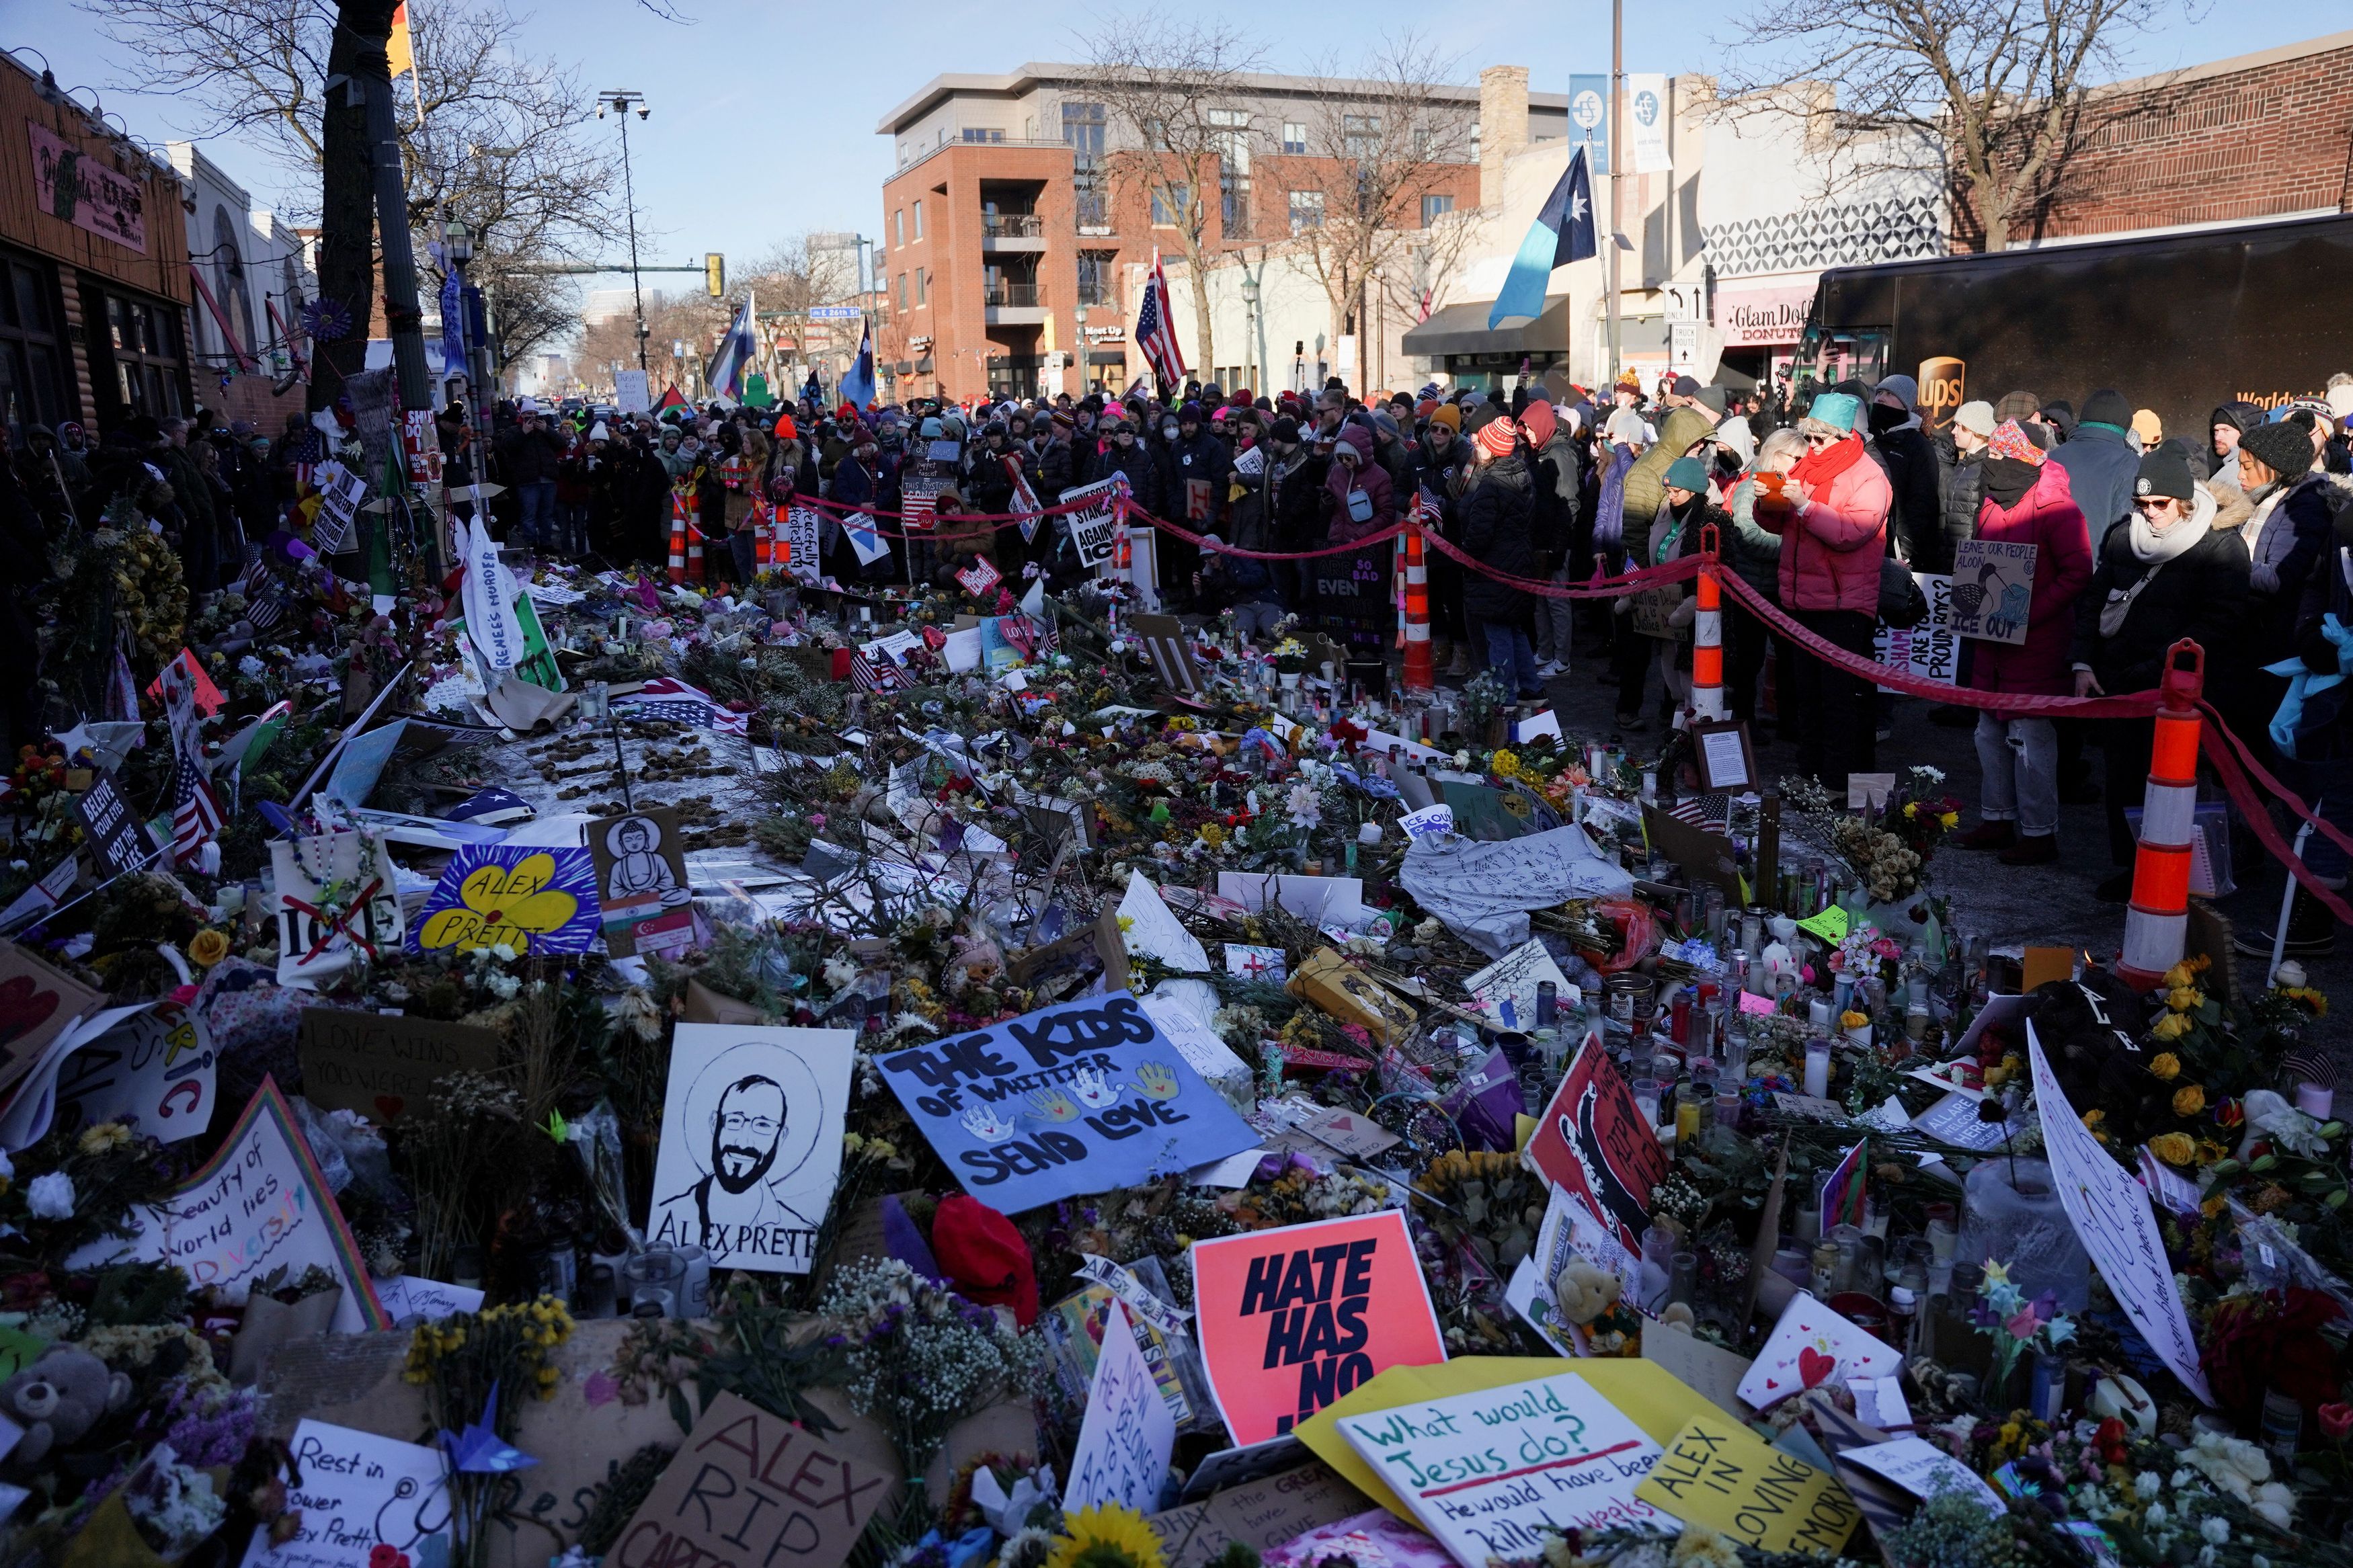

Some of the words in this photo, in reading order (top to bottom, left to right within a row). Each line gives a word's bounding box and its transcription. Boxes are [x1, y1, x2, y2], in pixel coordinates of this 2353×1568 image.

[829, 308, 847, 317] 26th
[849, 308, 860, 317] St
[1666, 311, 1683, 319] ONLY
[1734, 304, 1777, 328] Glam
[1085, 327, 1107, 335] Meet
[1109, 326, 1123, 336] Up
[1675, 328, 1696, 337] TRUCK
[1675, 337, 1696, 347] ROUTE
[1921, 376, 1962, 417] ups
[917, 462, 936, 470] puppet
[803, 509, 818, 568] Peacefully
[1078, 520, 1113, 548] AGAINS
[1081, 541, 1113, 565] IC
[1357, 559, 1373, 571] SO
[1958, 542, 1985, 554] LEAVE
[1988, 542, 2004, 556] OUR
[2005, 545, 2037, 560] PEOPLE
[481, 551, 500, 606] MURDER
[1317, 579, 1360, 597] EVEN
[1352, 569, 1380, 582] BAD
[1951, 612, 1981, 634] ICE
[1986, 616, 2018, 639] OUT
[1911, 637, 1930, 667] ARE
[1928, 630, 1954, 679] PROUD
[93, 812, 114, 839] YOUR
[109, 798, 124, 823] EYES
[1404, 815, 1423, 828] ICE
[107, 835, 127, 866] NOT
[121, 822, 138, 848] THE
[467, 872, 546, 899] ALEX
[310, 1019, 385, 1054] LOVE
[882, 1032, 1017, 1087] THE
[1007, 998, 1156, 1069] KIDS
[916, 1087, 963, 1118] OF
[1927, 1114, 1953, 1130] ALL
[1950, 1098, 1974, 1116] ARE
[1940, 1106, 1981, 1136] WELCOM
[1954, 1119, 1993, 1144] HERE
[959, 1130, 1088, 1186] SEND
[1084, 1098, 1190, 1142] LOVE
[241, 1174, 279, 1219] lies
[654, 1210, 729, 1251] ALEX
[1240, 1237, 1378, 1317] HATE
[1263, 1296, 1369, 1370] HAS
[1299, 1351, 1375, 1413] NO
[1352, 1407, 1461, 1446] What
[1474, 1384, 1570, 1426] would
[296, 1436, 361, 1475] Rest
[365, 1461, 385, 1479] in
[1386, 1447, 1508, 1488] Jesus
[1519, 1414, 1591, 1465] do?
[1652, 1426, 1727, 1499] ALEX
[694, 1414, 883, 1526] ALEX
[1703, 1458, 1743, 1494] IN
[289, 1482, 343, 1511] ower
[1433, 1497, 1468, 1521] He
[1476, 1482, 1545, 1516] would
[1546, 1467, 1613, 1492] have
[677, 1463, 820, 1568] RIP
[1150, 1505, 1211, 1537] OHN
[1788, 1477, 1856, 1555] EMORY
[323, 1517, 374, 1551] Pretti
